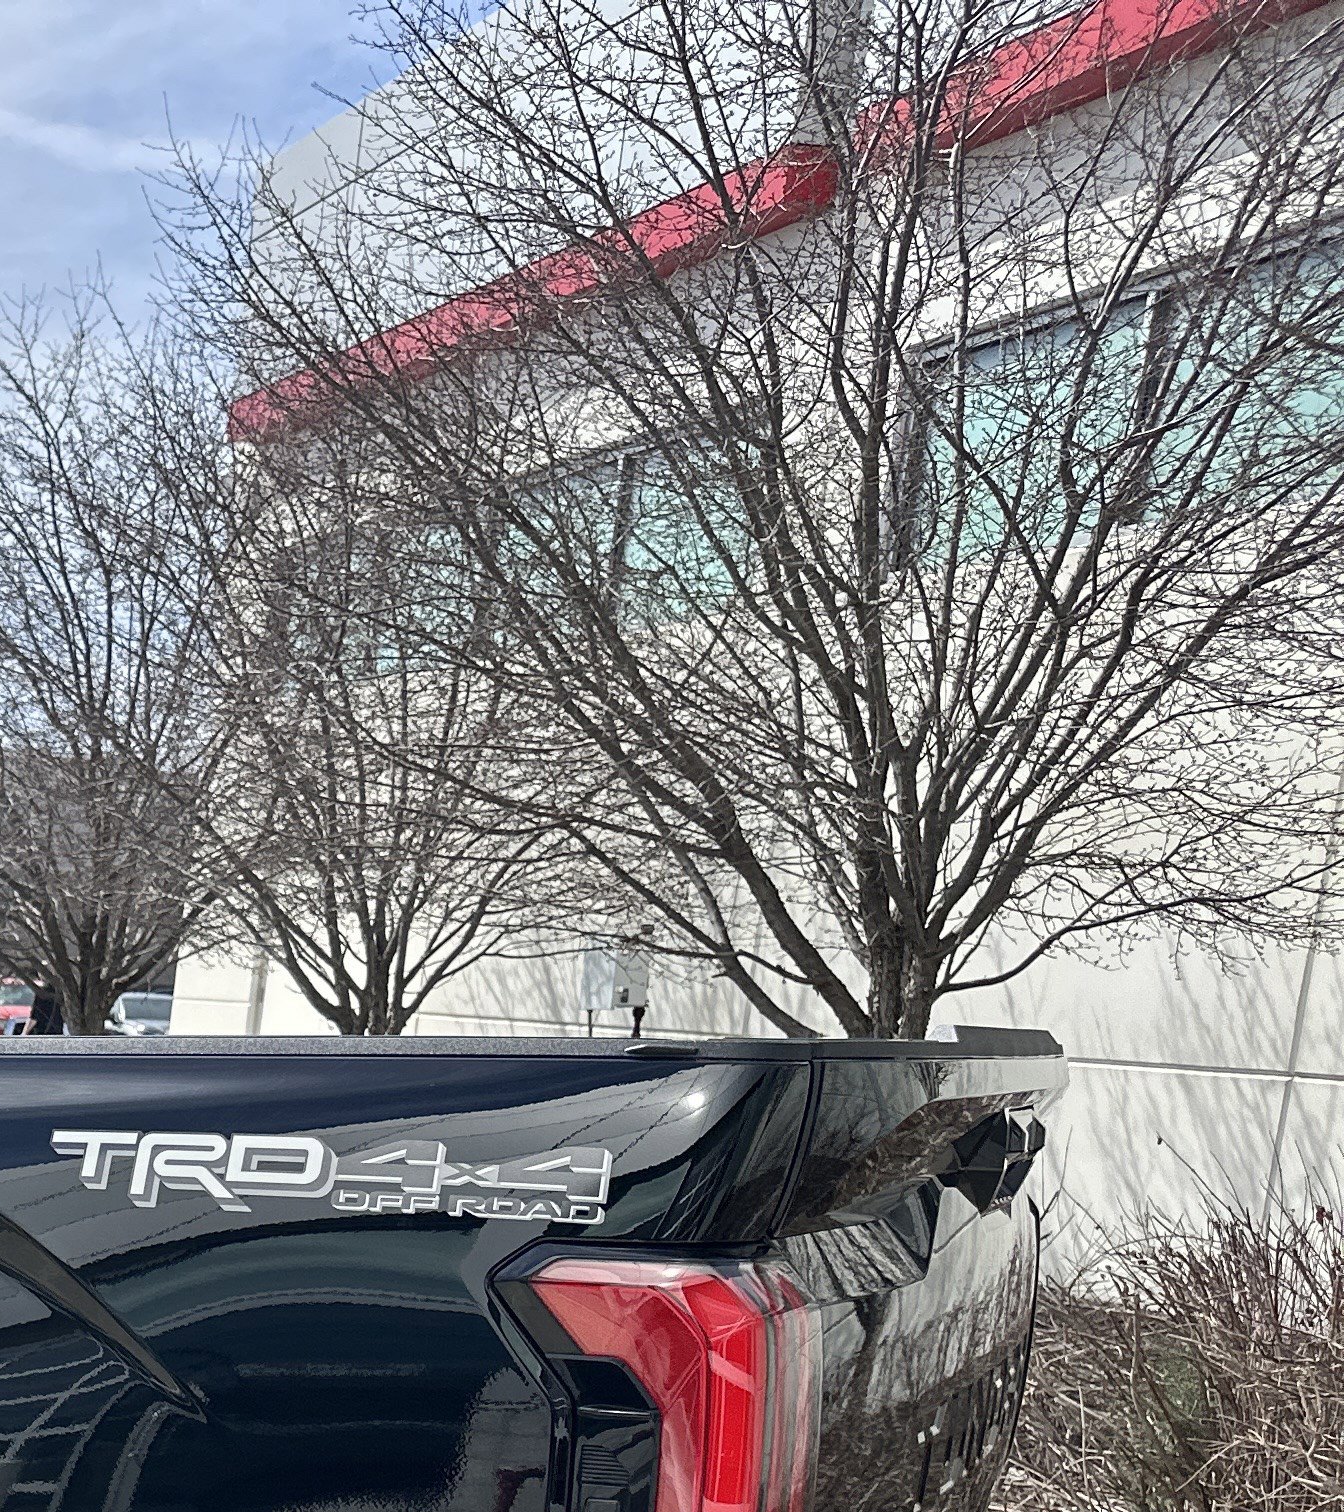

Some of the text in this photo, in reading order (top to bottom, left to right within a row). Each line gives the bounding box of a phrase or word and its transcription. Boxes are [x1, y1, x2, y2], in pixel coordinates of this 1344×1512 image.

[50, 1130, 339, 1212] TRD
[331, 1189, 606, 1226] OFF ROAD
